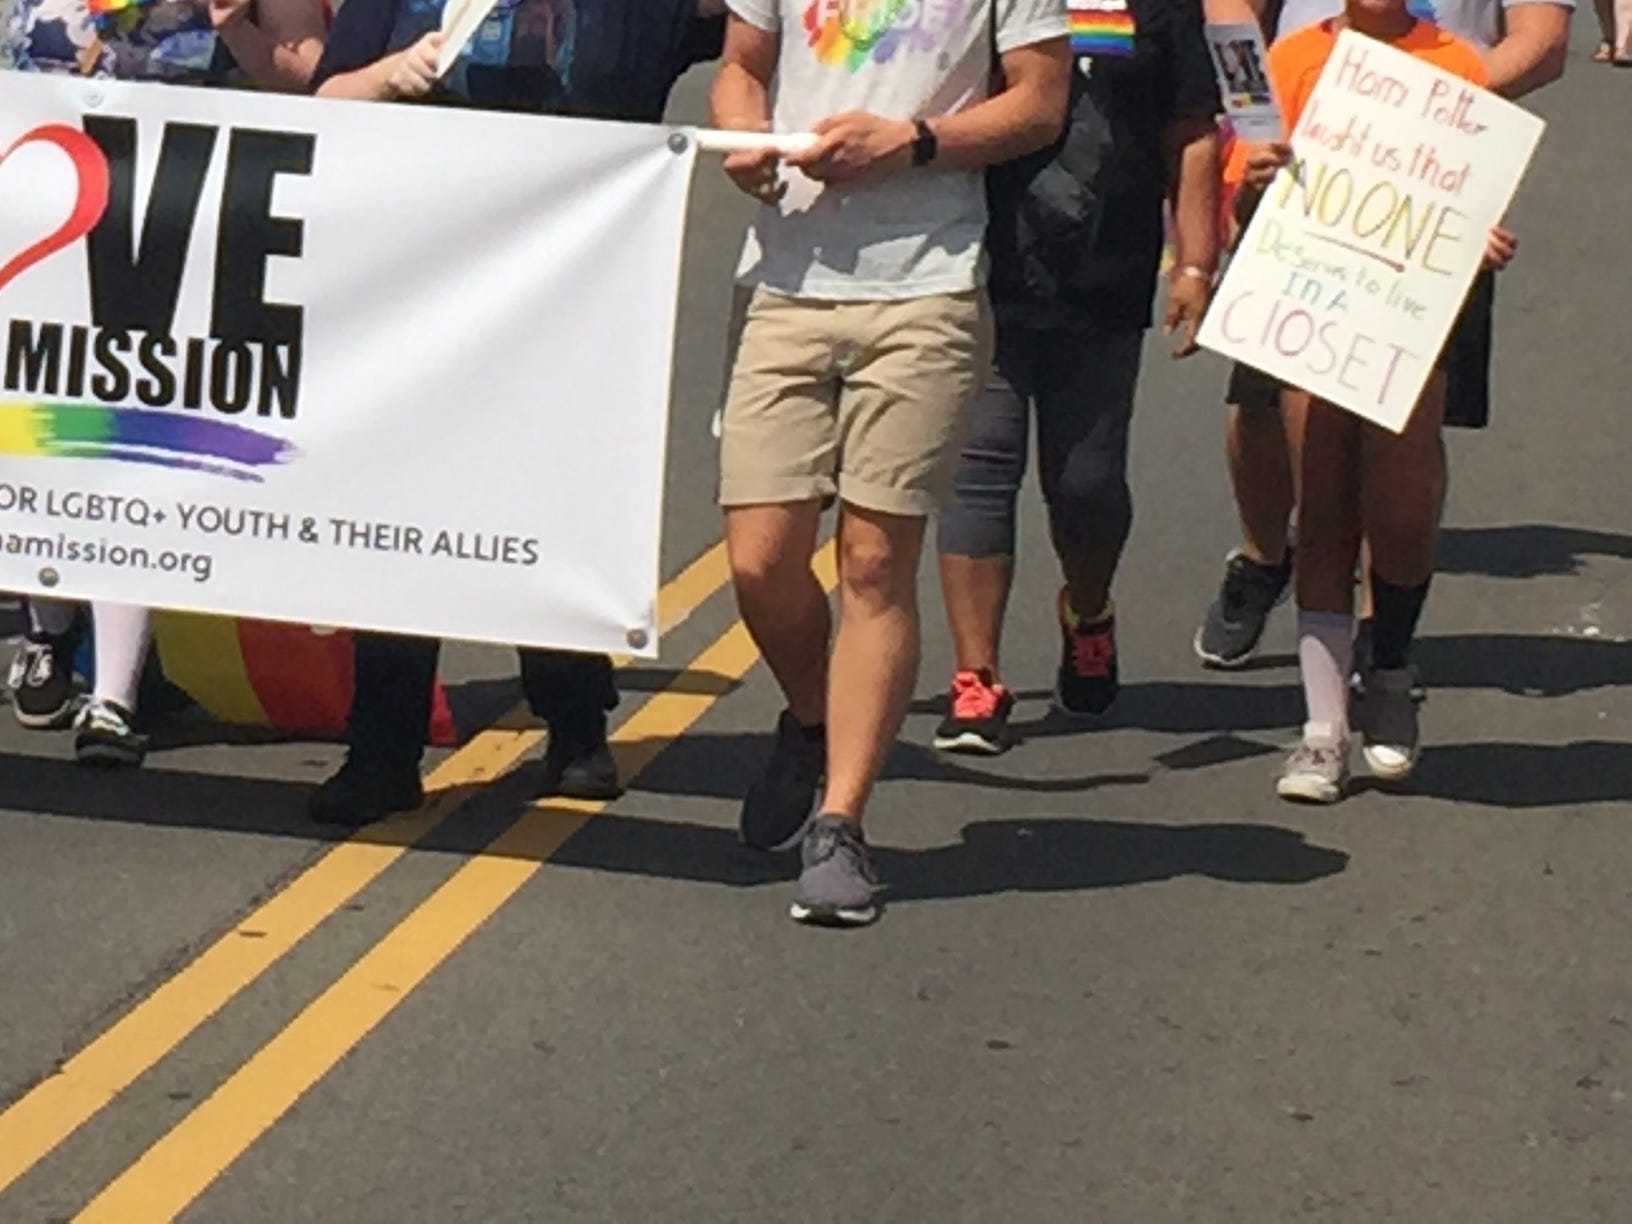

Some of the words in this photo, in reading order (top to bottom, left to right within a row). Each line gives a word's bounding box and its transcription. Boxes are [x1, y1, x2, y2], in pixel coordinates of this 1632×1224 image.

[1421, 78, 1488, 135] Potter
[1371, 142, 1402, 172] us
[1408, 143, 1471, 196] that
[1278, 157, 1354, 228] NO
[1352, 180, 1469, 276] ONE
[1355, 267, 1381, 294] to
[1385, 278, 1428, 321] live
[3, 319, 304, 419] MISSION
[47, 490, 166, 527] LGBTQ+
[176, 503, 289, 541] YOUTH
[297, 517, 319, 544] &
[328, 518, 424, 556] THEIR
[431, 530, 539, 566] ALLIES
